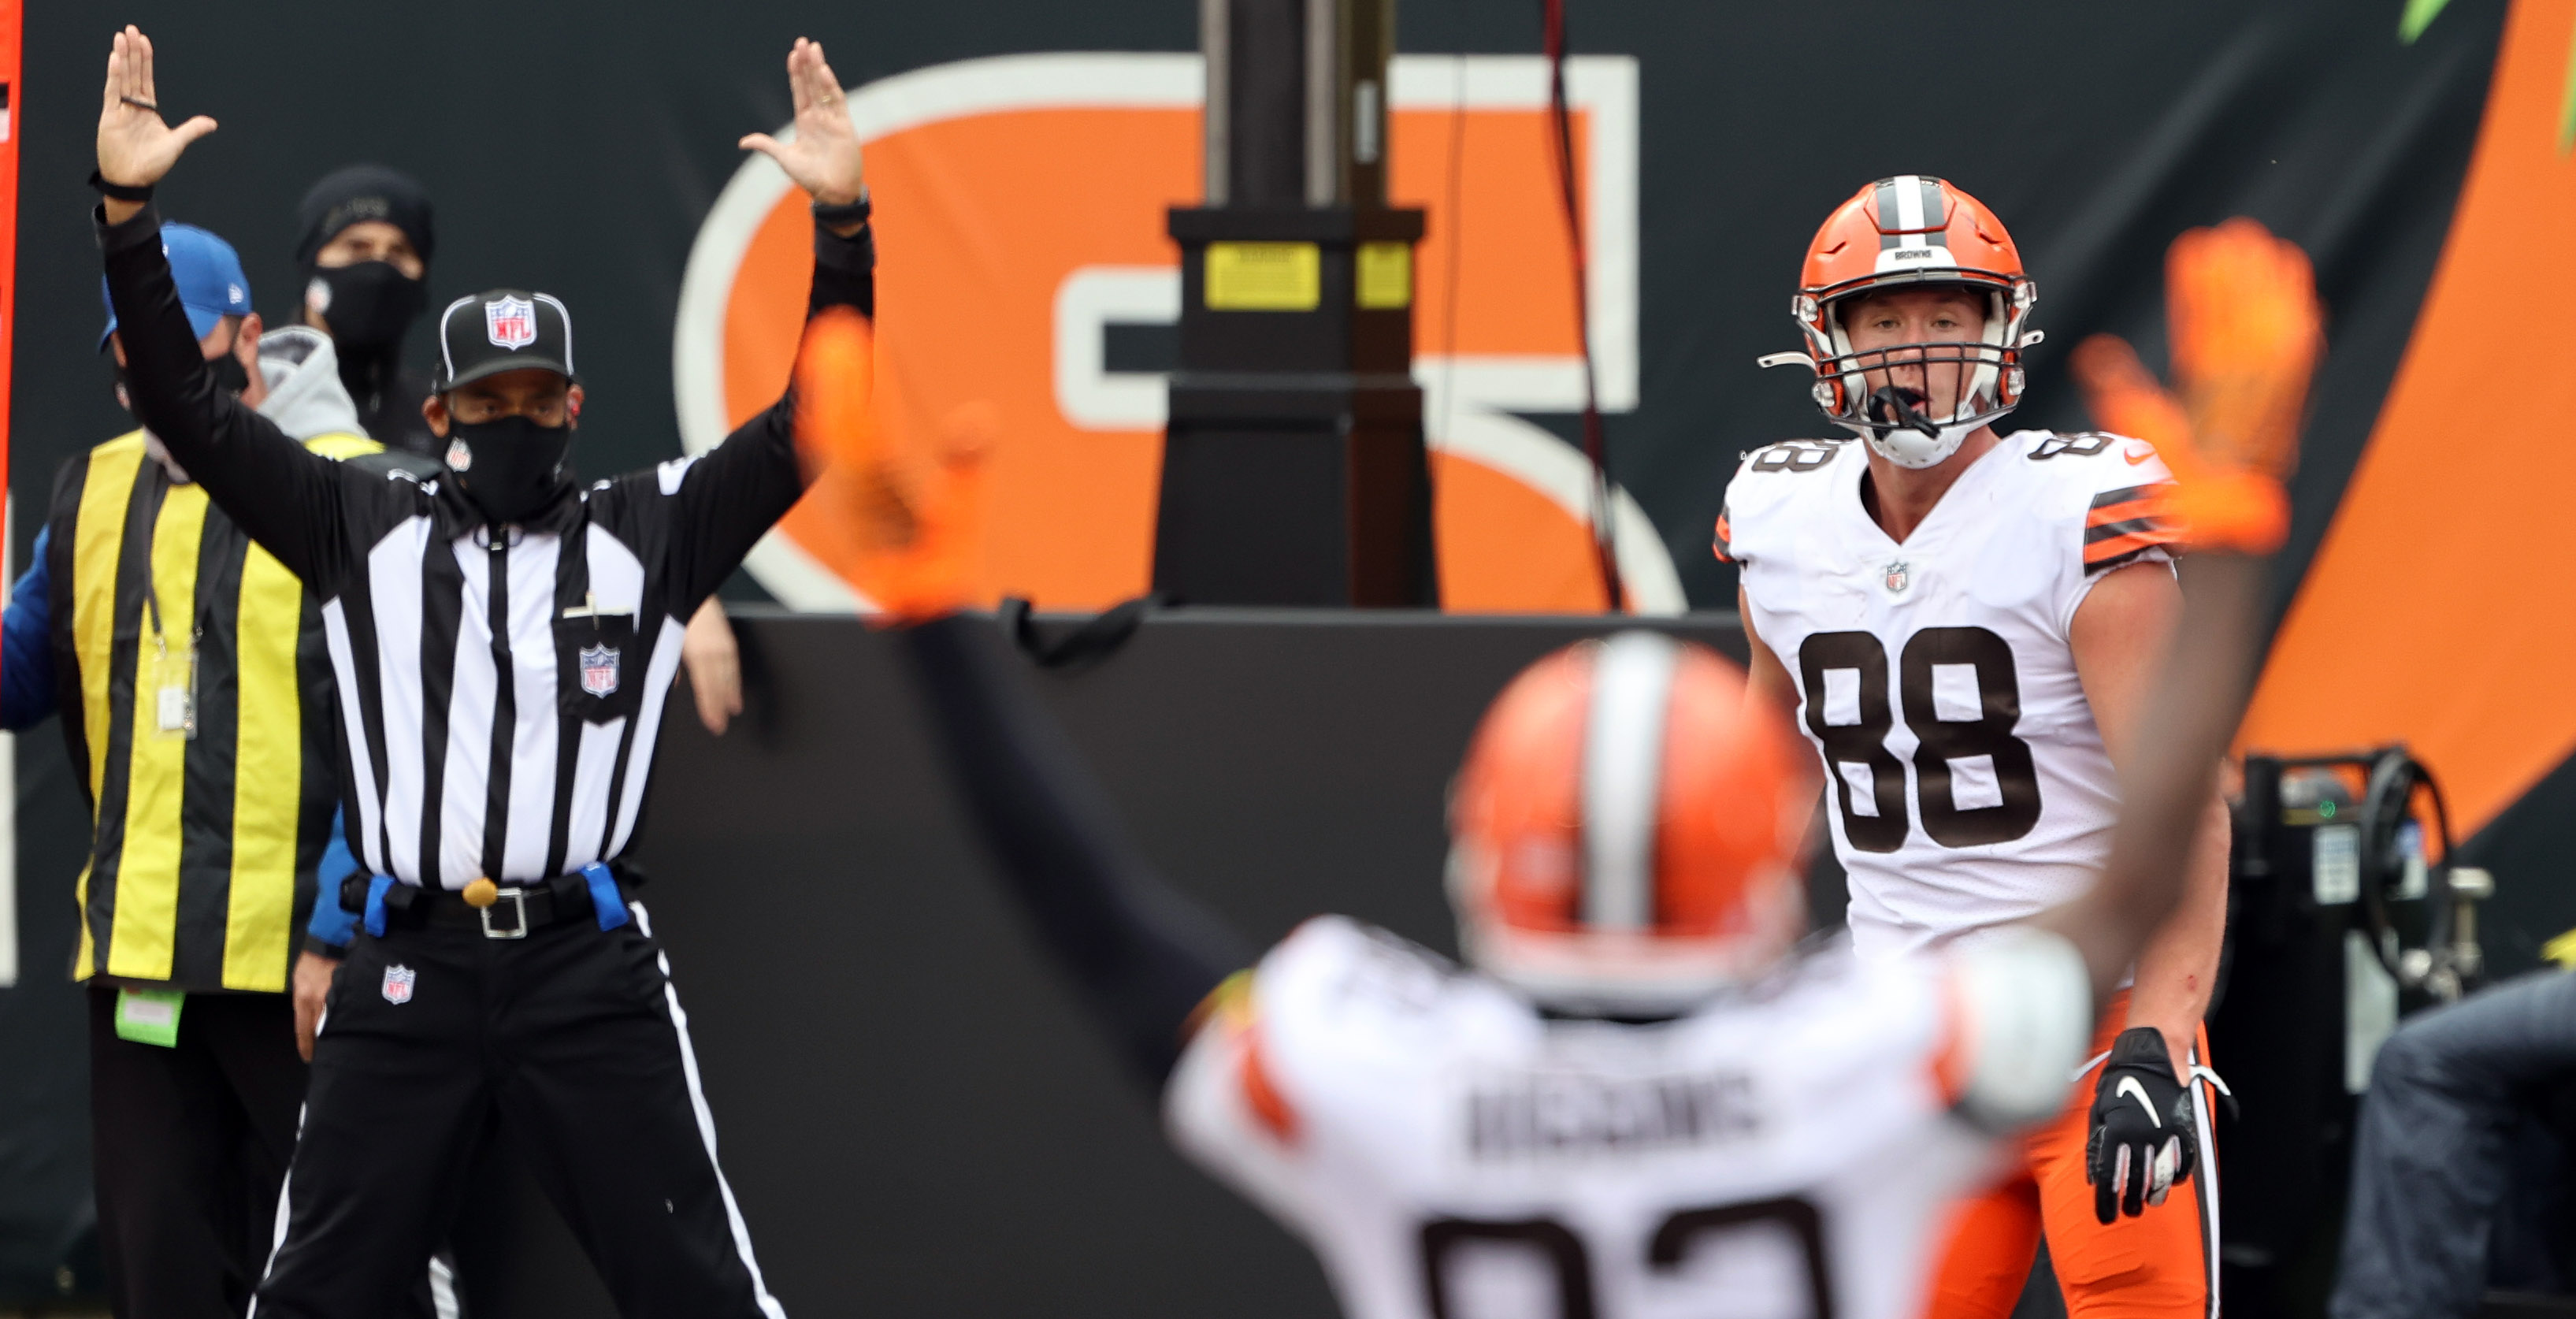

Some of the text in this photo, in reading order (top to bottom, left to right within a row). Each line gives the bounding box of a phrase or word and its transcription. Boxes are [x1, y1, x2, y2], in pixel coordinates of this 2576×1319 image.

[1895, 249, 1932, 261] BROWNS
[493, 318, 533, 342] NFL
[1887, 574, 1906, 589] NFL
[585, 668, 616, 691] NFL
[1798, 626, 2042, 853] 88
[387, 982, 410, 1000] NFL
